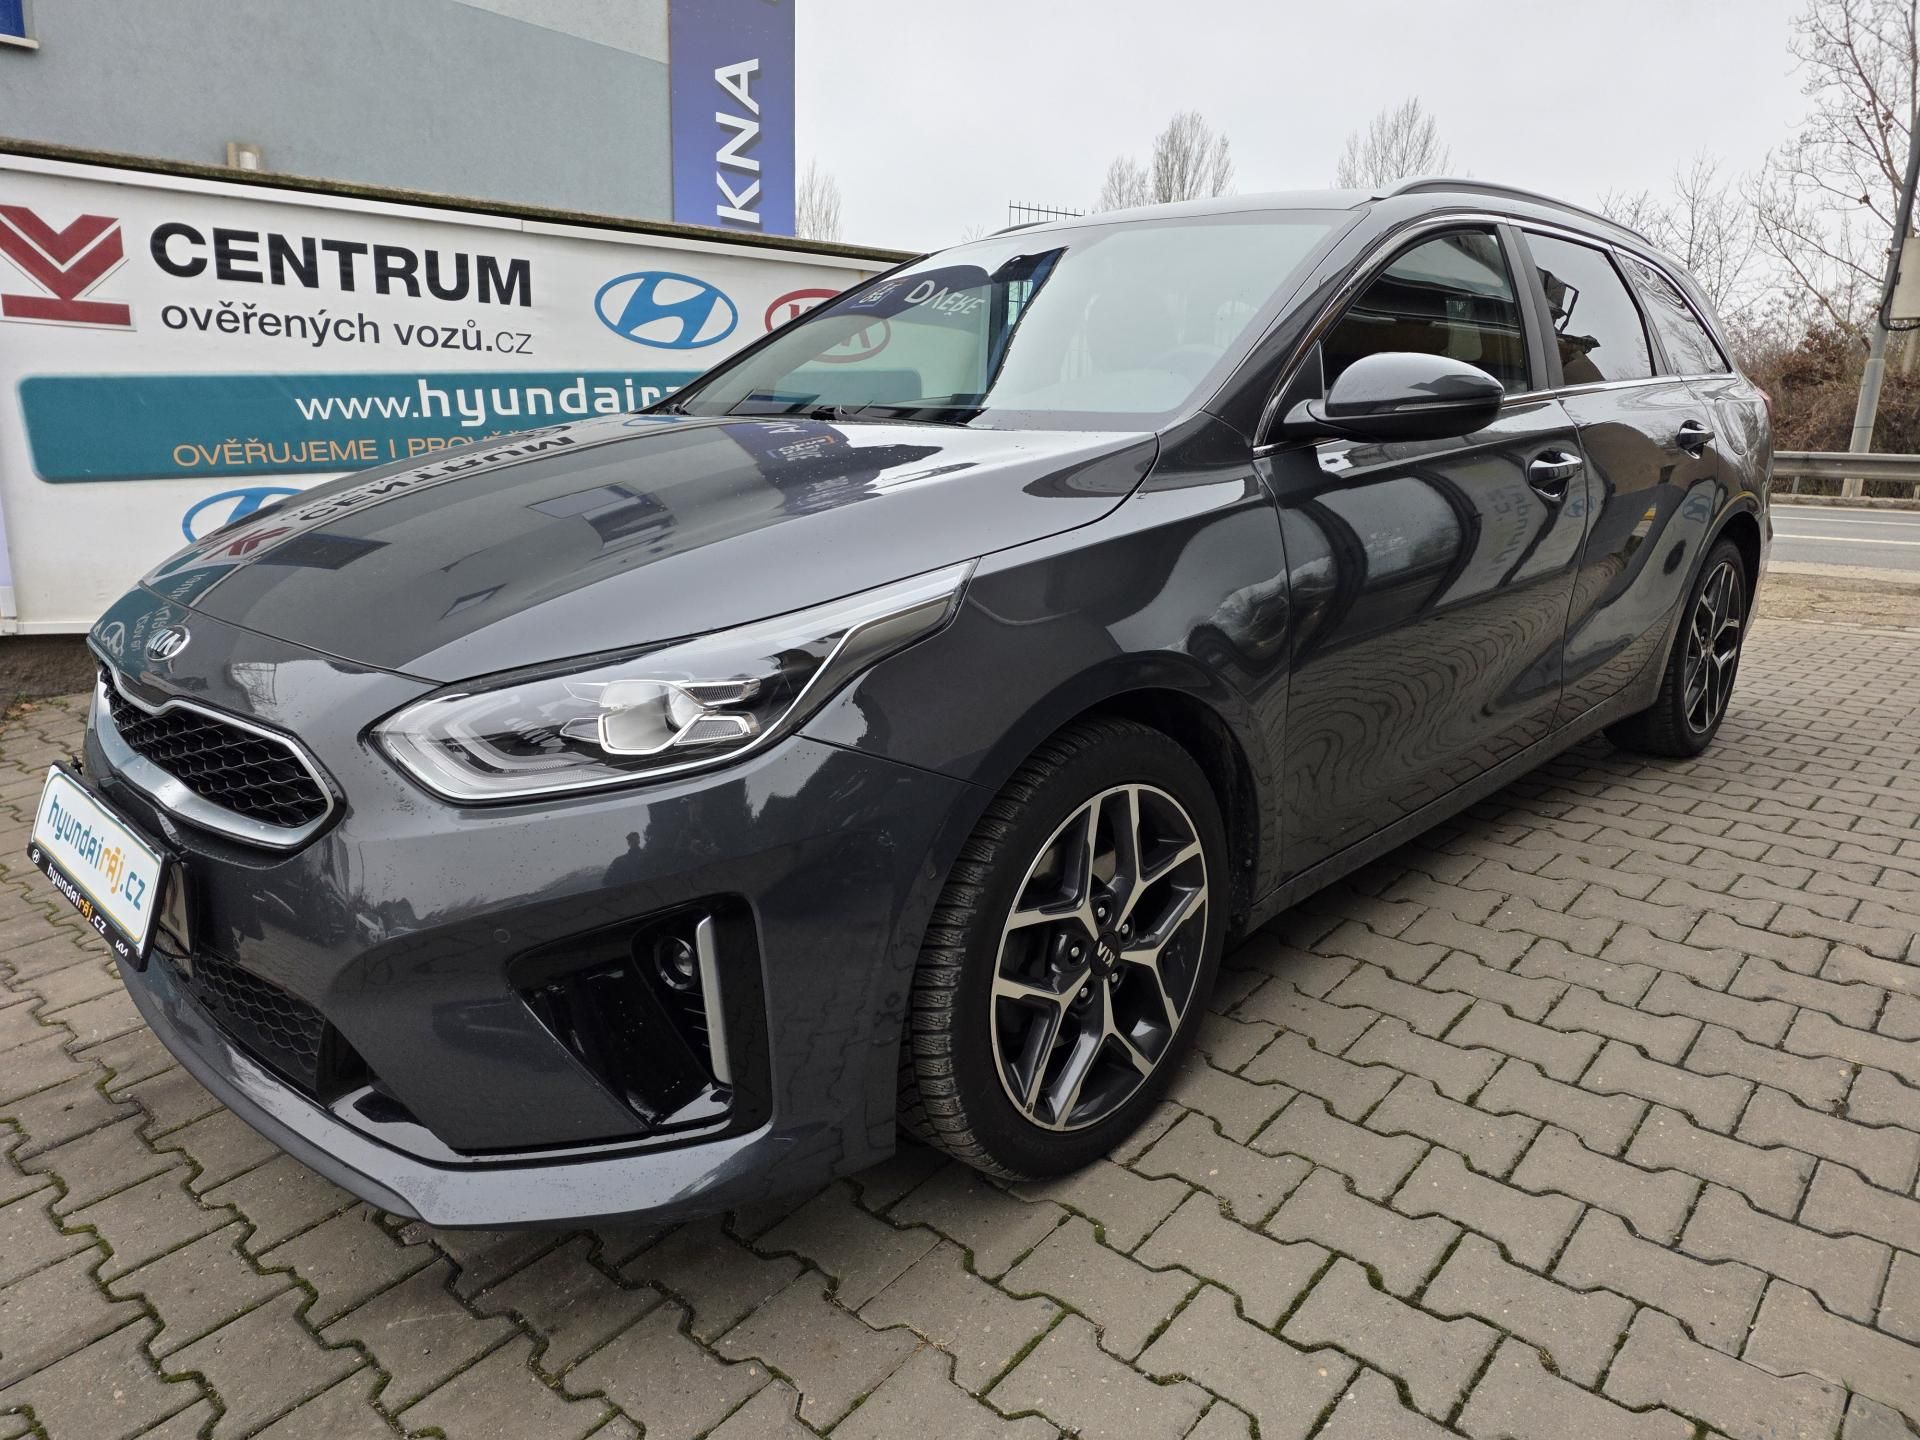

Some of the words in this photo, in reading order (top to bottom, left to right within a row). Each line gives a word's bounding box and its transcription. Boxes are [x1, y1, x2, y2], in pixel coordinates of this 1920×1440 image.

[149, 221, 533, 308] CENTRUM
[160, 300, 381, 348] ověřených
[294, 376, 681, 428] www.hyundair
[172, 437, 379, 468] OVĚŘUJEME
[388, 438, 397, 459] I
[1096, 941, 1116, 968] KIA
